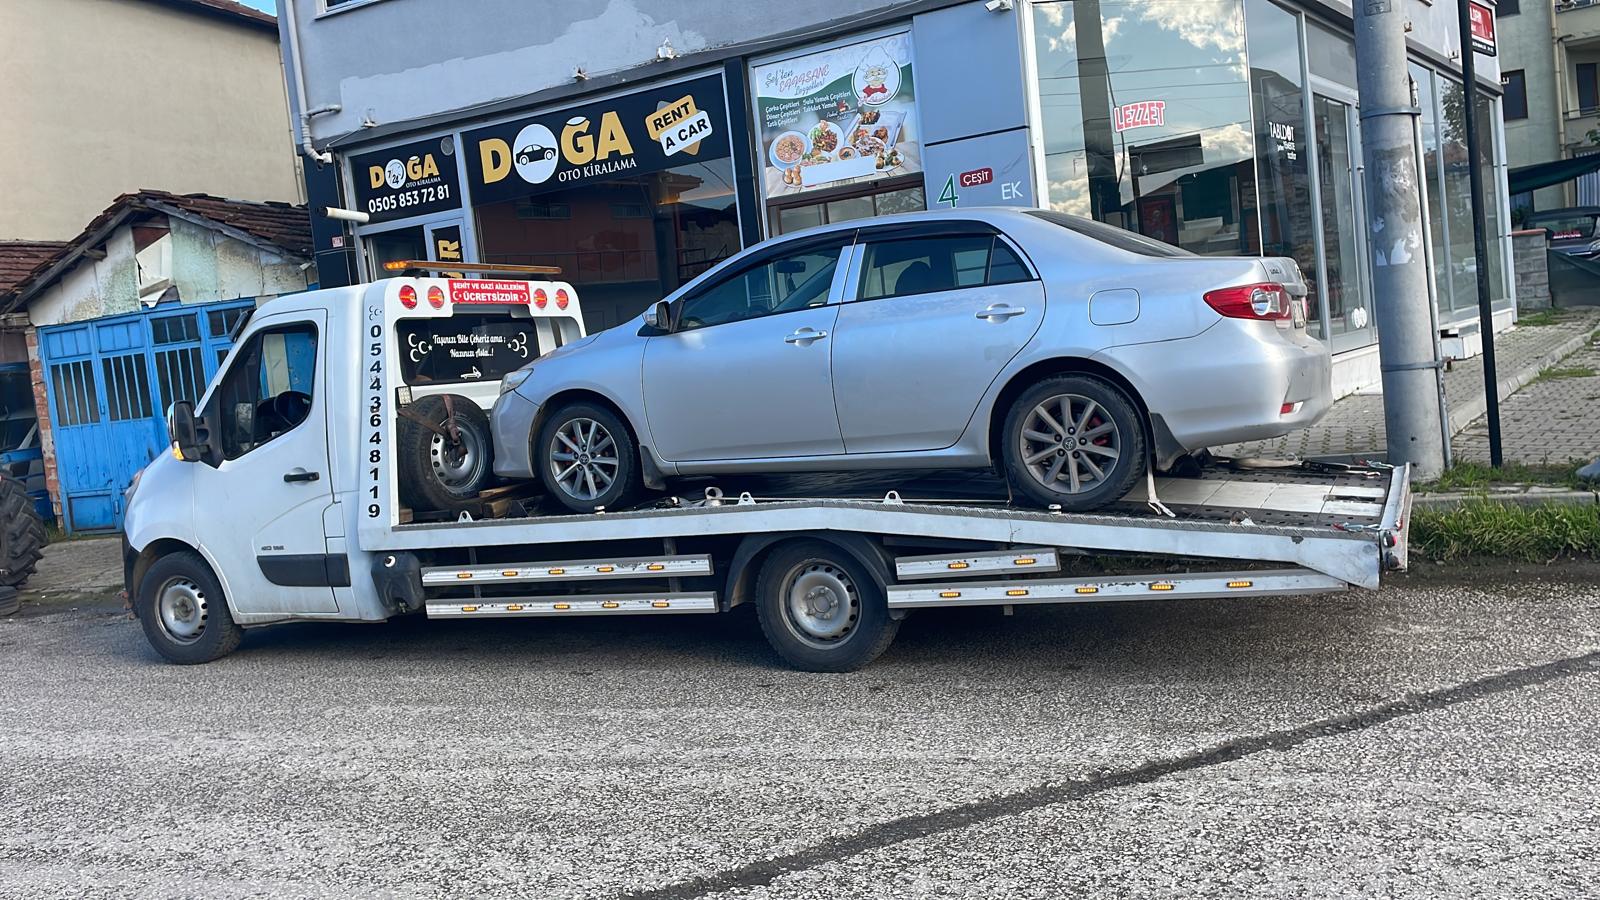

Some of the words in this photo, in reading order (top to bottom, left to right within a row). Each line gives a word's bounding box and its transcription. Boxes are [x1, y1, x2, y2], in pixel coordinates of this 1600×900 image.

[814, 95, 829, 104] Yemek
[821, 101, 837, 111] Yemek
[653, 101, 691, 131] RENT
[1113, 100, 1166, 133] LEZZET
[664, 136, 675, 150] A
[677, 118, 709, 142] CAR
[558, 170, 581, 182] OTO
[583, 157, 637, 178] KİRALAMA
[963, 170, 990, 186] ÇEŞİT
[417, 177, 441, 186] KİRALAMA
[368, 195, 397, 213] 0505
[399, 190, 419, 207] 853
[421, 187, 435, 203] 72
[437, 184, 450, 199] 81
[937, 173, 959, 208] 4
[1001, 181, 1023, 200] EK
[453, 282, 471, 290] ŞEHİT
[495, 283, 526, 291] AİLELERİNE
[463, 291, 519, 302] ÜCRETSİZDİR
[457, 334, 469, 344] Bile
[470, 333, 490, 346] Çekeriz
